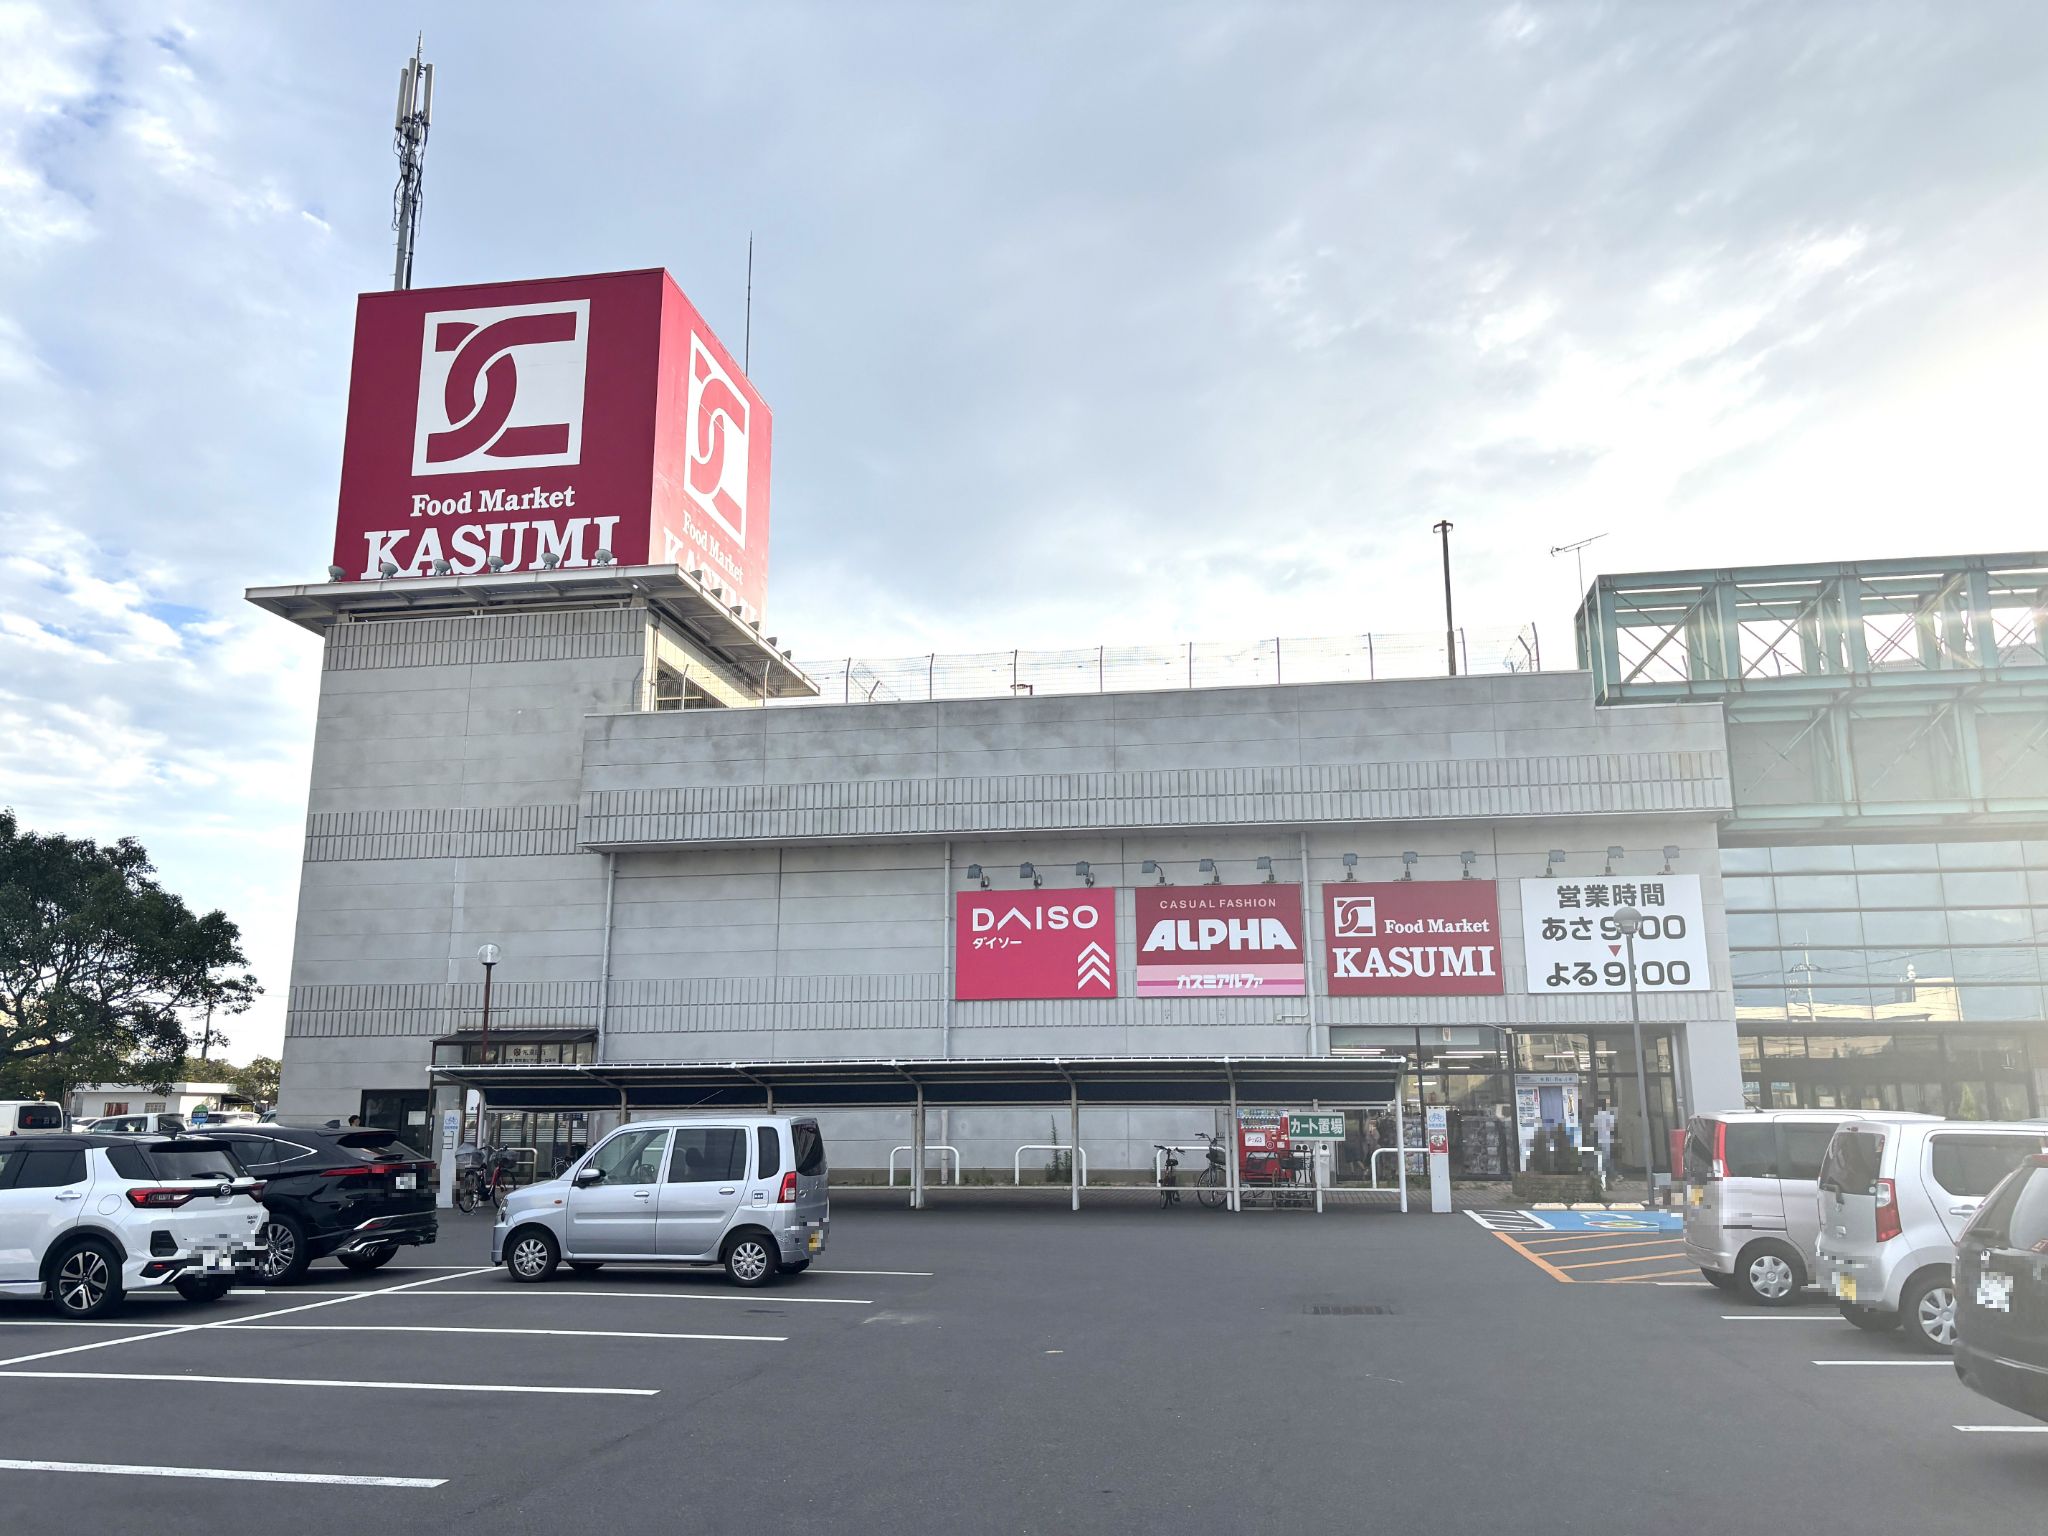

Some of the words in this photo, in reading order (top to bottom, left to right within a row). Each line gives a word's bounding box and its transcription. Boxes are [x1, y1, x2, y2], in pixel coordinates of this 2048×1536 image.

[410, 490, 472, 517] Food
[477, 486, 576, 513] Market
[361, 516, 620, 580] KASUMI
[682, 510, 707, 551] Food
[709, 534, 743, 585] Market
[1159, 899, 1216, 910] CASUAL
[1219, 898, 1276, 909] FASHION
[1557, 883, 1664, 908] 営業時間
[973, 905, 1099, 932] DAISO
[1384, 919, 1425, 934] Food
[1426, 918, 1490, 934] Market
[1541, 915, 1686, 941] あさ900
[972, 936, 1022, 950] ダイソー
[1142, 917, 1298, 952] ALPHA
[1332, 946, 1496, 978] KASUMI
[1176, 973, 1264, 990] カスミアルファ
[1291, 1118, 1343, 1135] カート置場
